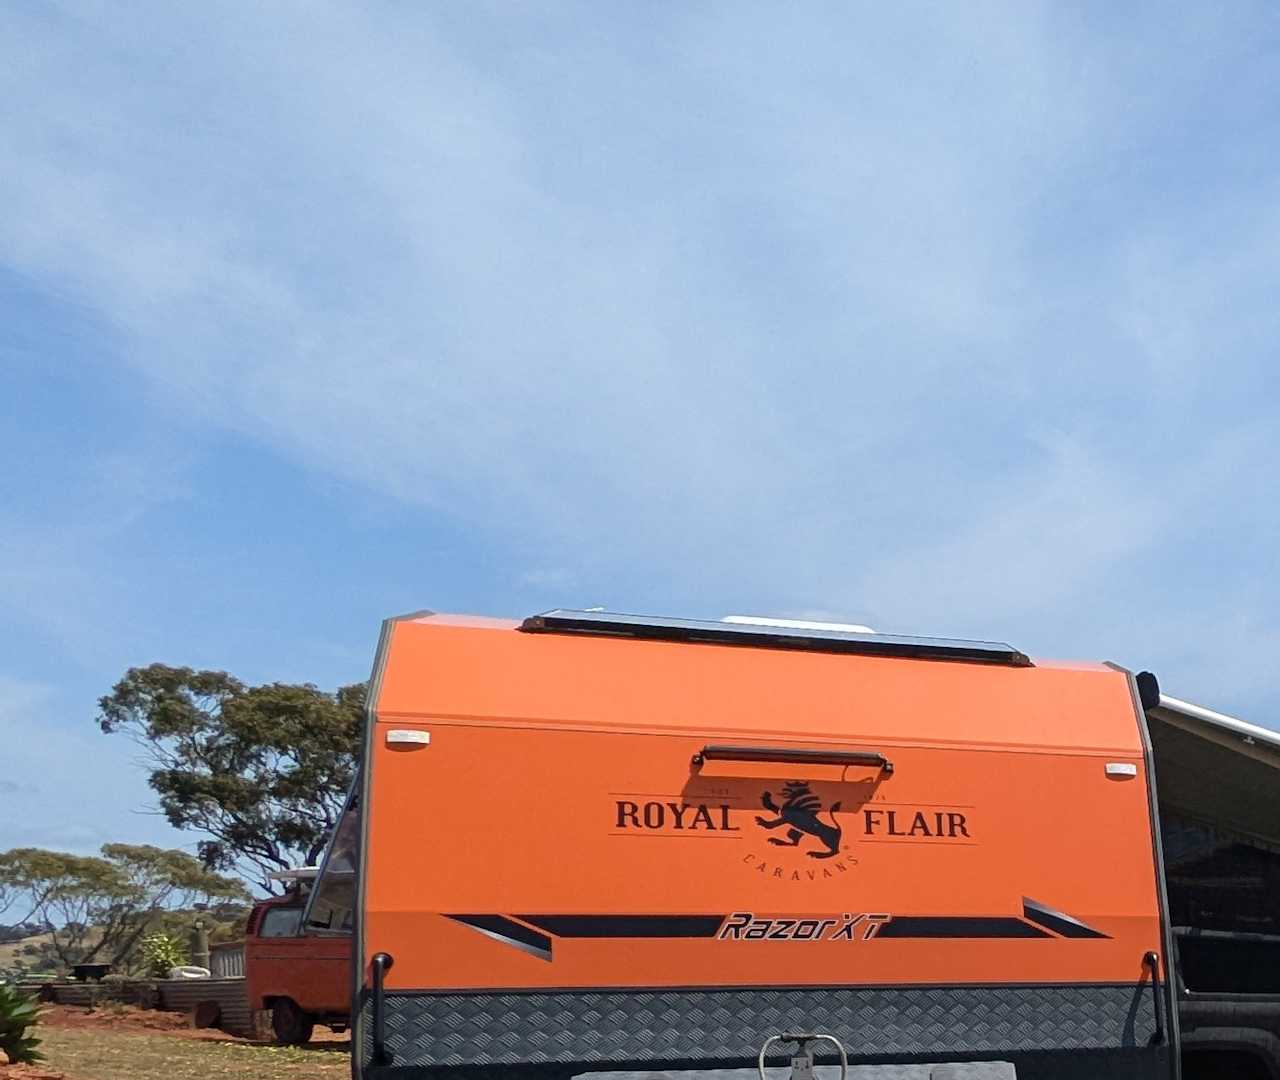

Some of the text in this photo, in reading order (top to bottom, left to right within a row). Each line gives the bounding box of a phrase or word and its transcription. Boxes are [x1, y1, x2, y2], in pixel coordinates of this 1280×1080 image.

[615, 800, 972, 839] ROYAL FLAIR
[742, 853, 859, 881] CARAVANS
